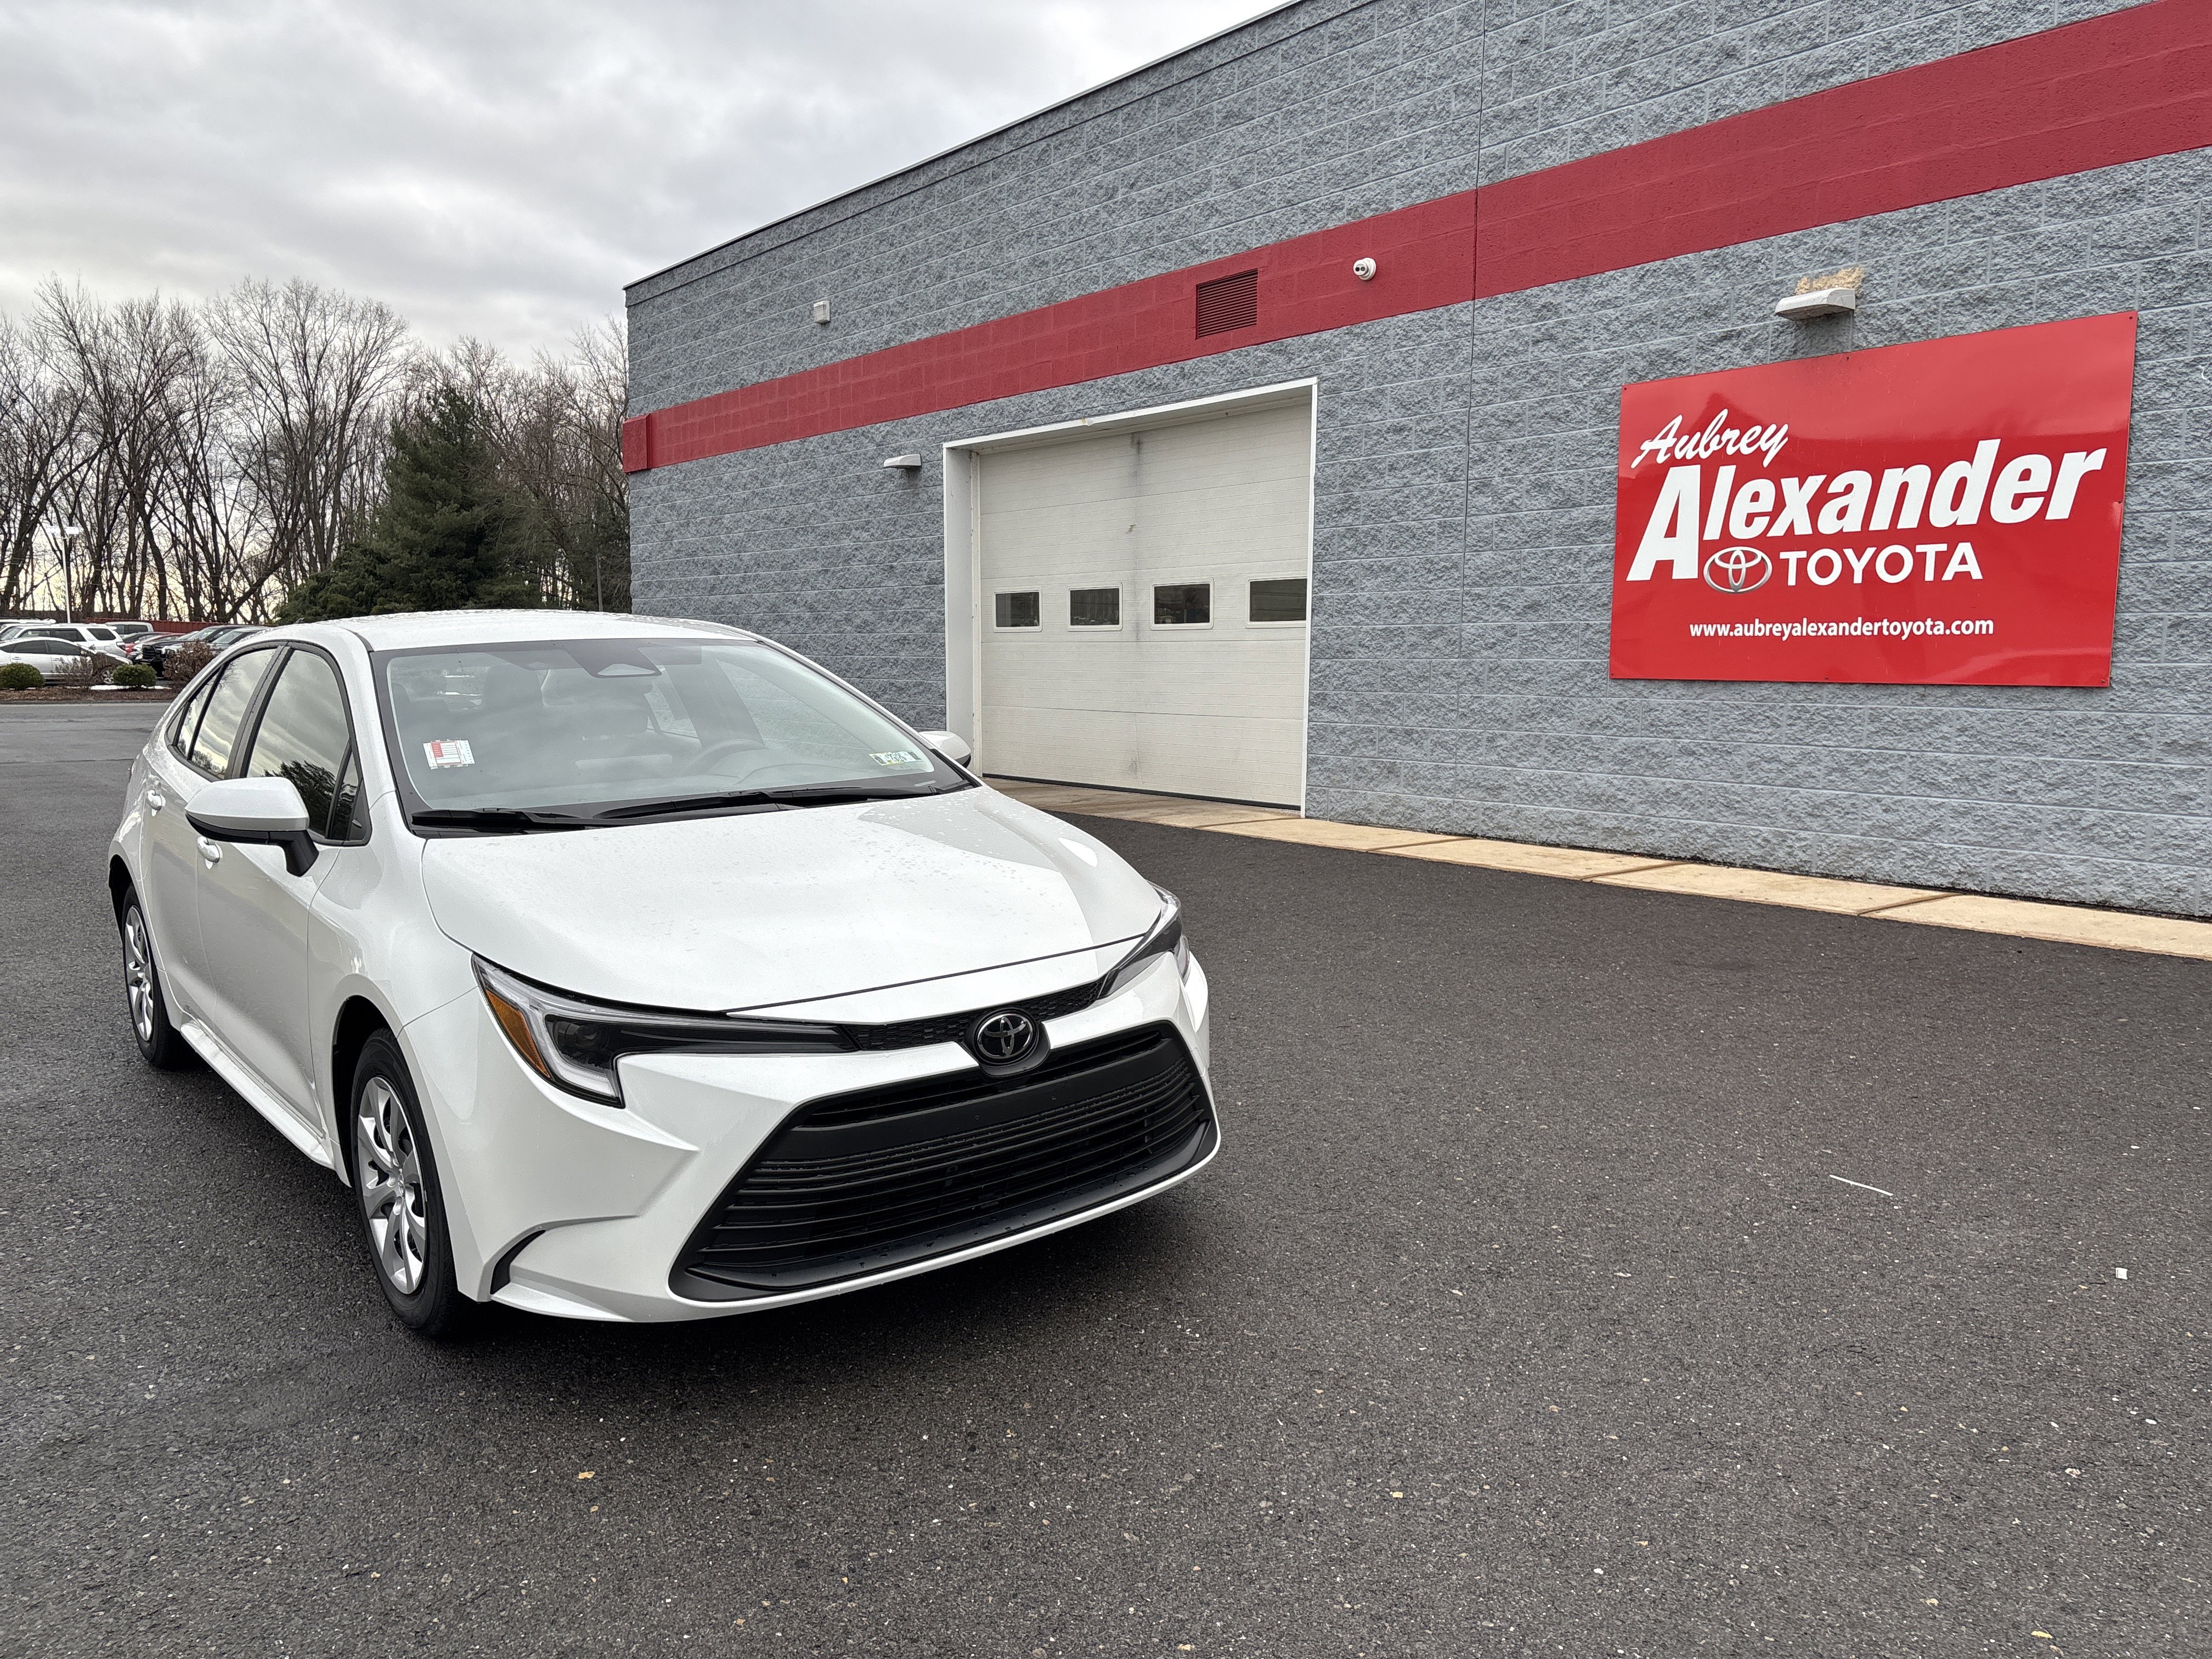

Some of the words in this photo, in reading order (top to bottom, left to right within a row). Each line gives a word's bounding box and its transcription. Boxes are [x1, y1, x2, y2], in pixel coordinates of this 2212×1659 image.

[1630, 408, 1788, 469] Aubrey
[1626, 438, 2107, 582] Alexander
[1779, 542, 1983, 586] TOYOTA
[1689, 617, 1994, 641] www.aubreyalexandertoyota.com
